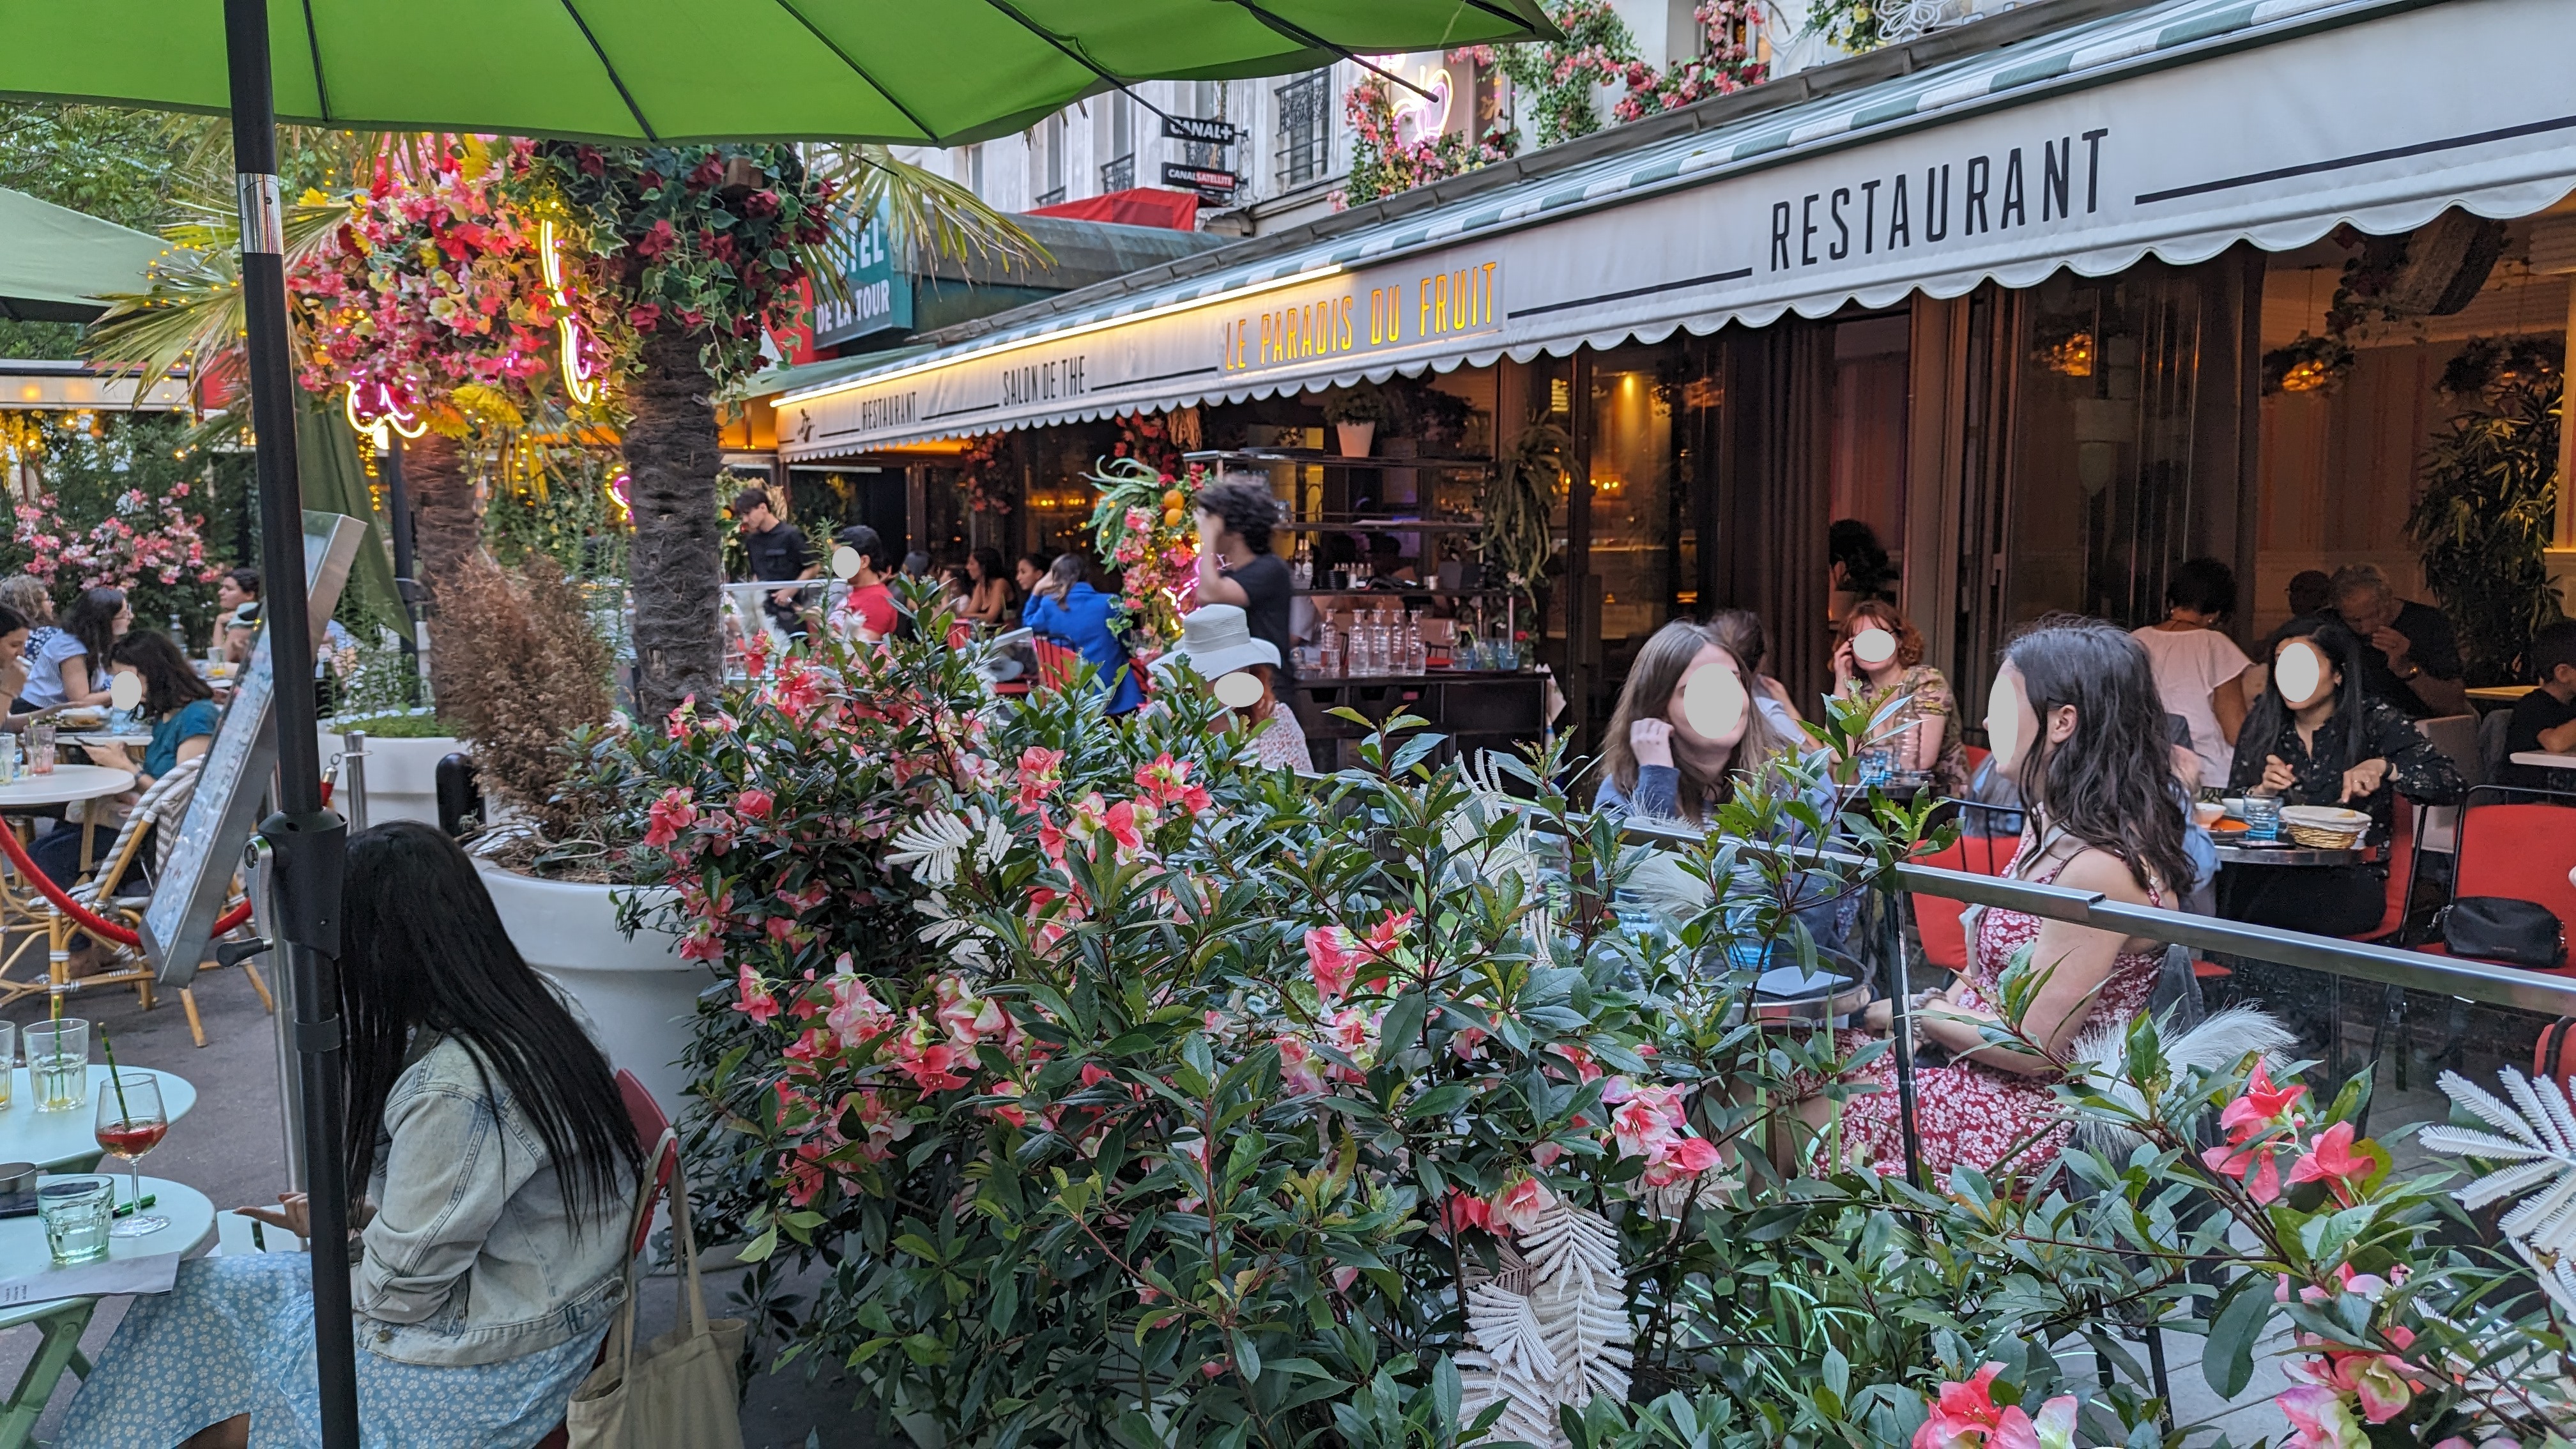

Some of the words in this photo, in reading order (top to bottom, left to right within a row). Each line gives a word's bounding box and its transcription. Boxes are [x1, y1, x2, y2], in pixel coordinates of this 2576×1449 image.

[1170, 119, 1232, 140] CANAL+
[1771, 128, 2108, 272] RESTAURANT
[816, 300, 832, 335] DE
[836, 298, 852, 328] LA
[855, 279, 890, 321] TOUR
[1226, 319, 1246, 371] LE
[1261, 296, 1353, 365] PARADIS
[1370, 284, 1400, 346] DU
[1420, 261, 1497, 337] FRUIT
[1004, 365, 1038, 406] SALON
[1043, 361, 1056, 400] DE
[1061, 356, 1085, 396] THE
[862, 391, 917, 431] RESTAURANT
